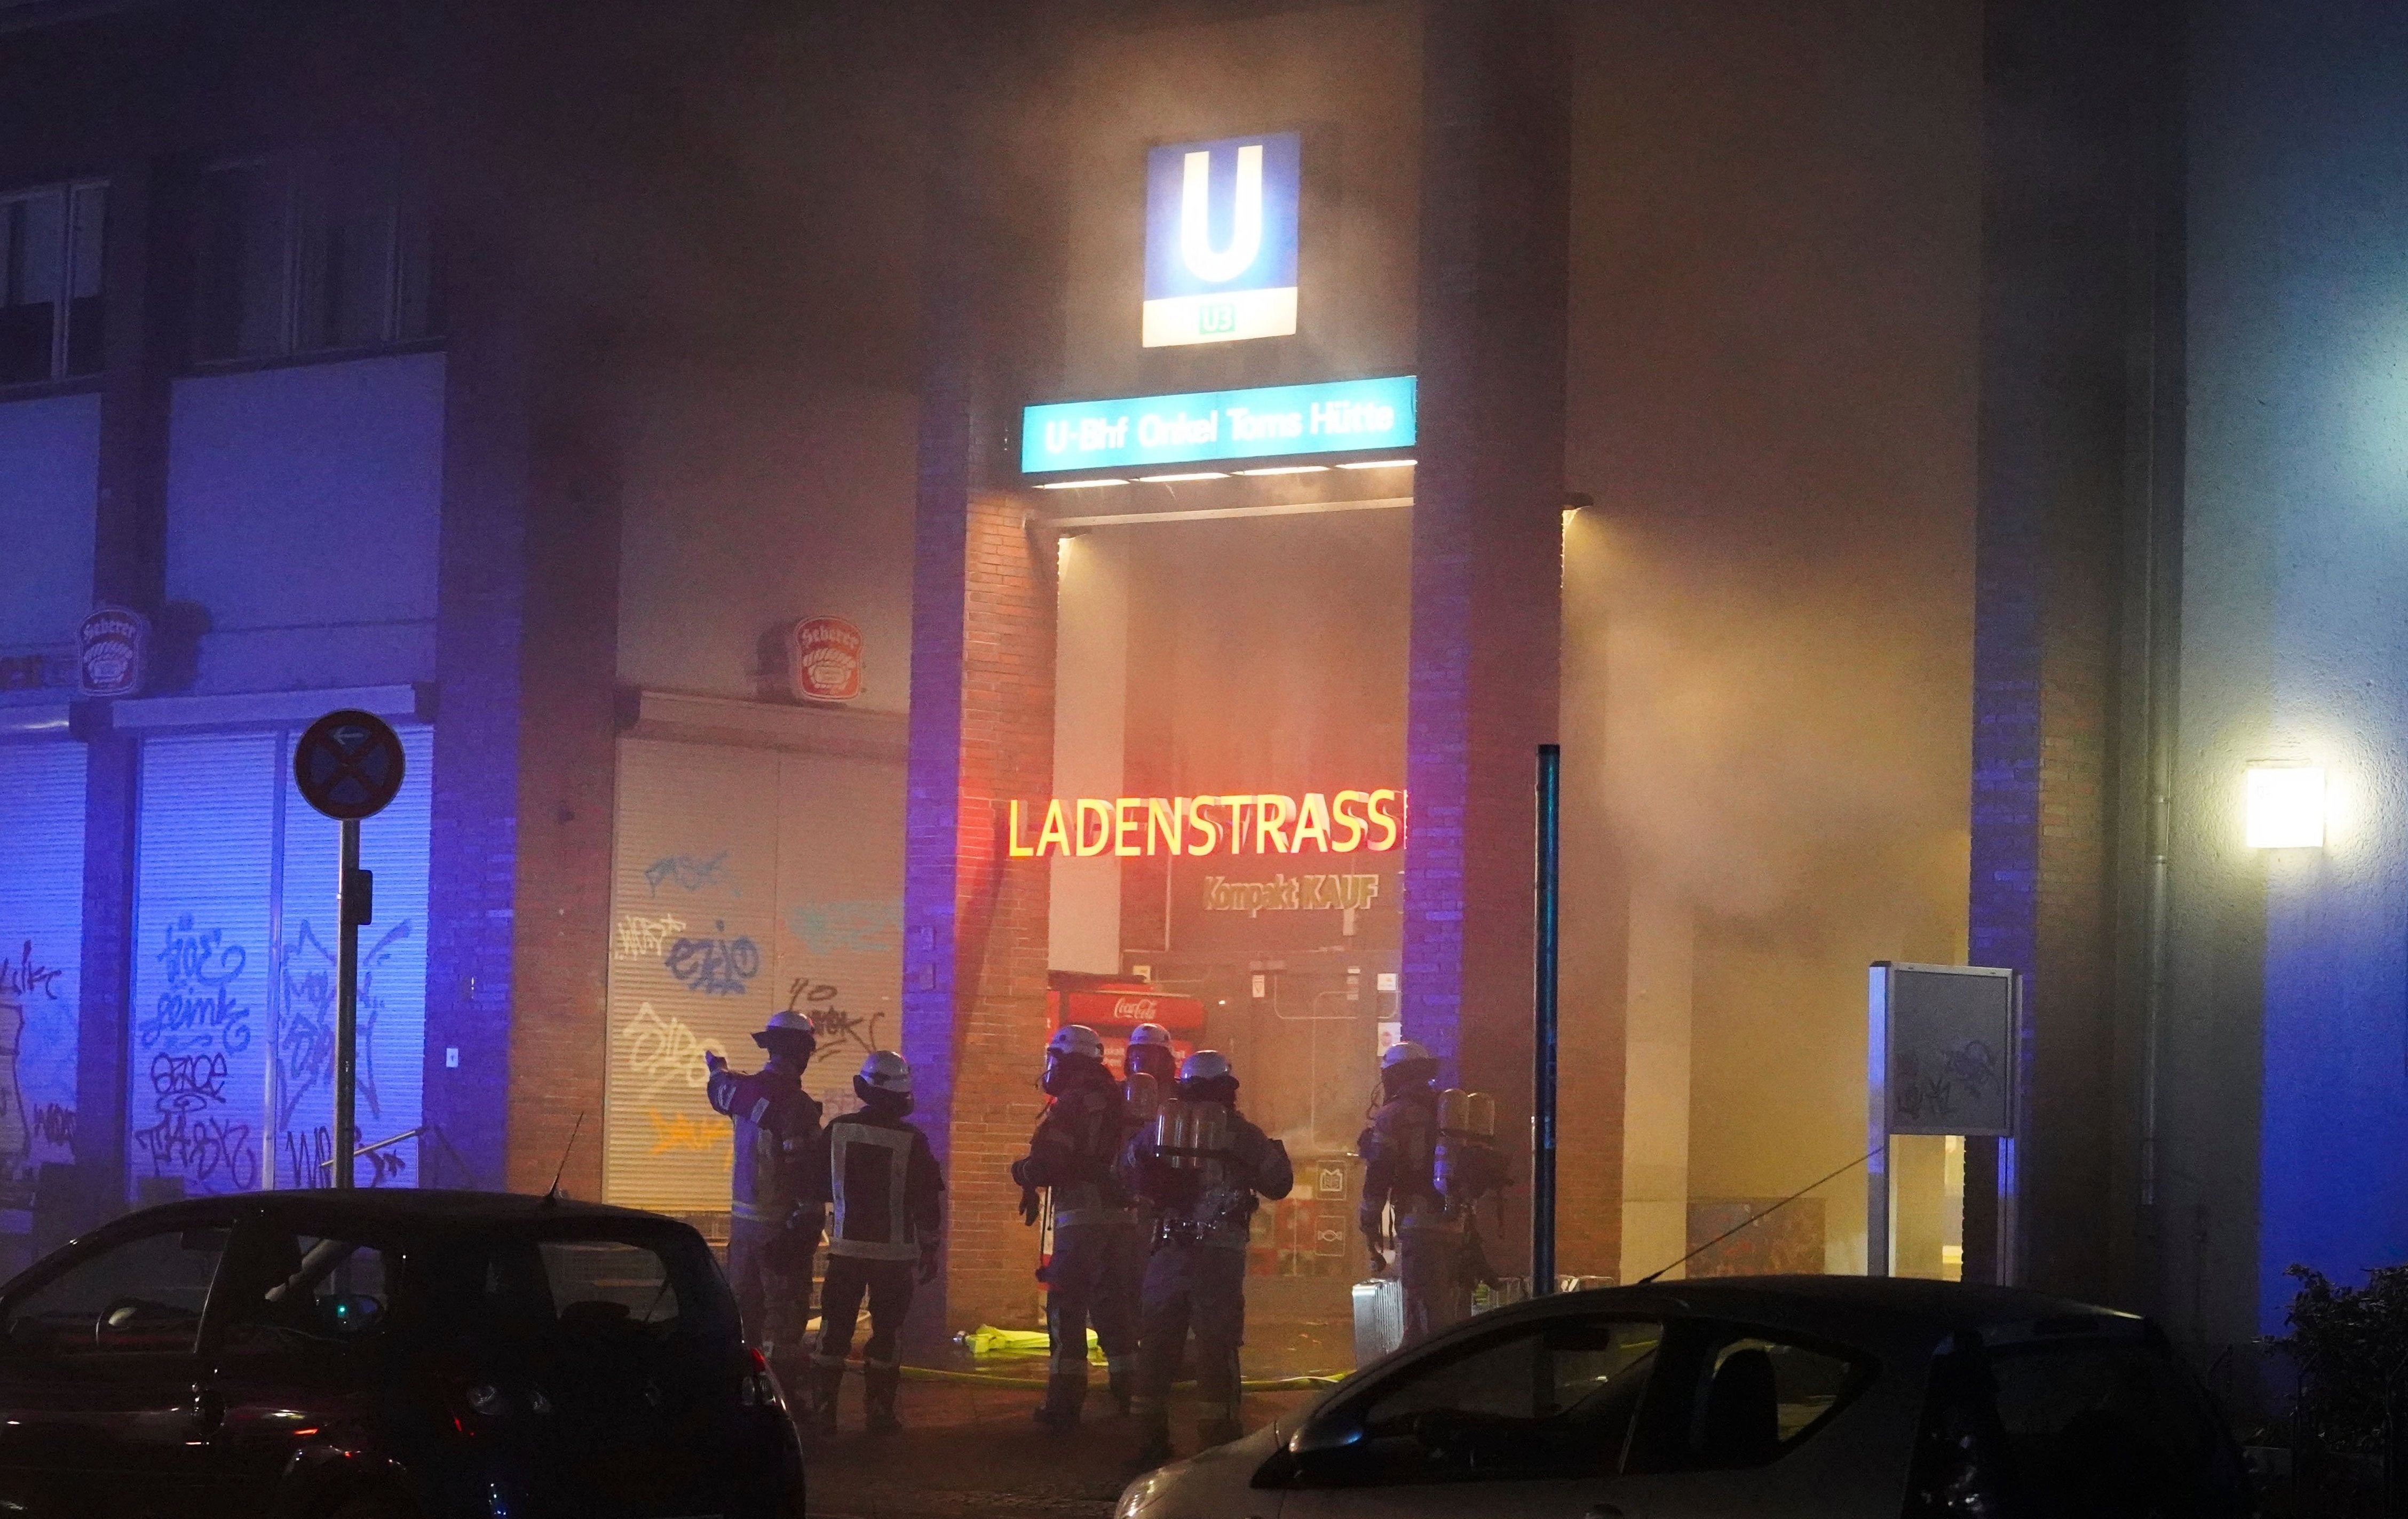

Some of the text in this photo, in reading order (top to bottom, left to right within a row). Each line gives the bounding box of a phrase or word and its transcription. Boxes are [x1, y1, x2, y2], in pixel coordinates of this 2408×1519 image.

[1180, 145, 1263, 282] U
[1203, 306, 1233, 331] U3
[1045, 401, 1394, 453] U-Bhf Onkel Toms Hütte
[1009, 789, 1408, 857] LADENSTRASS
[1204, 874, 1379, 918] Kompakt KAUF
